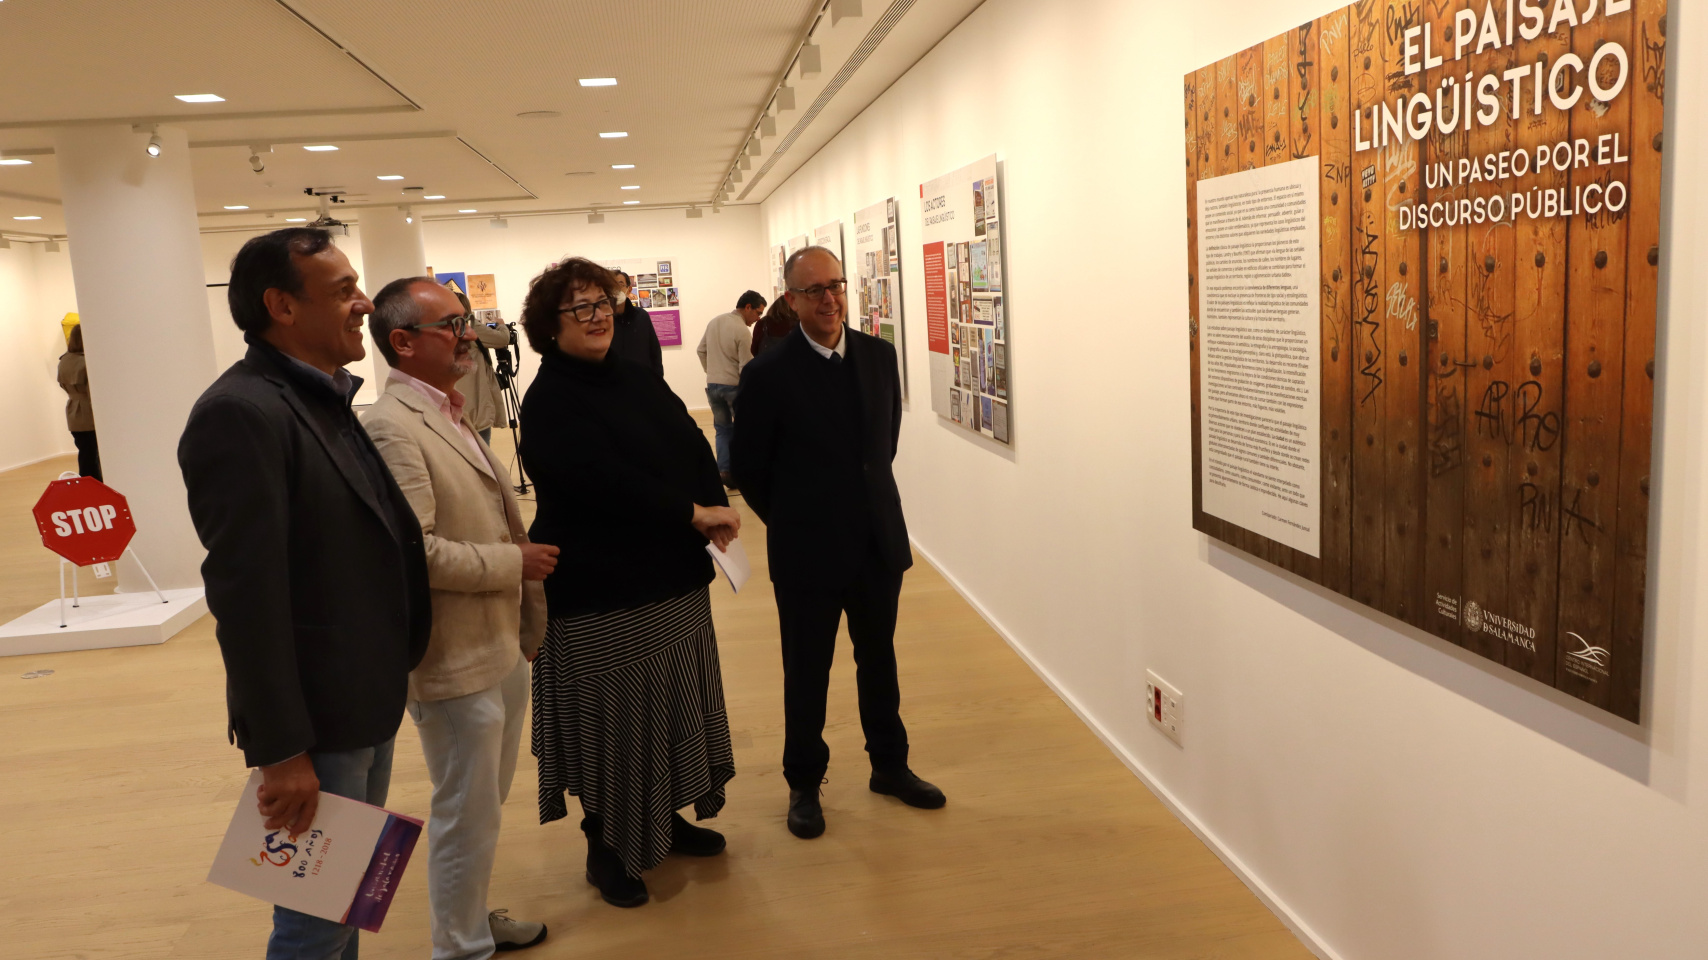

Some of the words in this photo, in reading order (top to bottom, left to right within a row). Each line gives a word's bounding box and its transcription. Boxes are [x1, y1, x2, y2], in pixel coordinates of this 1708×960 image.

[1404, 22, 1443, 76] EL
[1355, 42, 1628, 152] LINGÜÍSTICO
[1425, 160, 1453, 189] UN
[1458, 148, 1529, 185] PASEO
[1536, 138, 1589, 174] POR
[1597, 133, 1628, 165] EL
[1399, 195, 1505, 230] DISCURSO
[1511, 181, 1626, 220] PÚBLICO
[51, 504, 117, 538] STOP
[293, 860, 308, 878] 800
[320, 837, 332, 855] 2018
